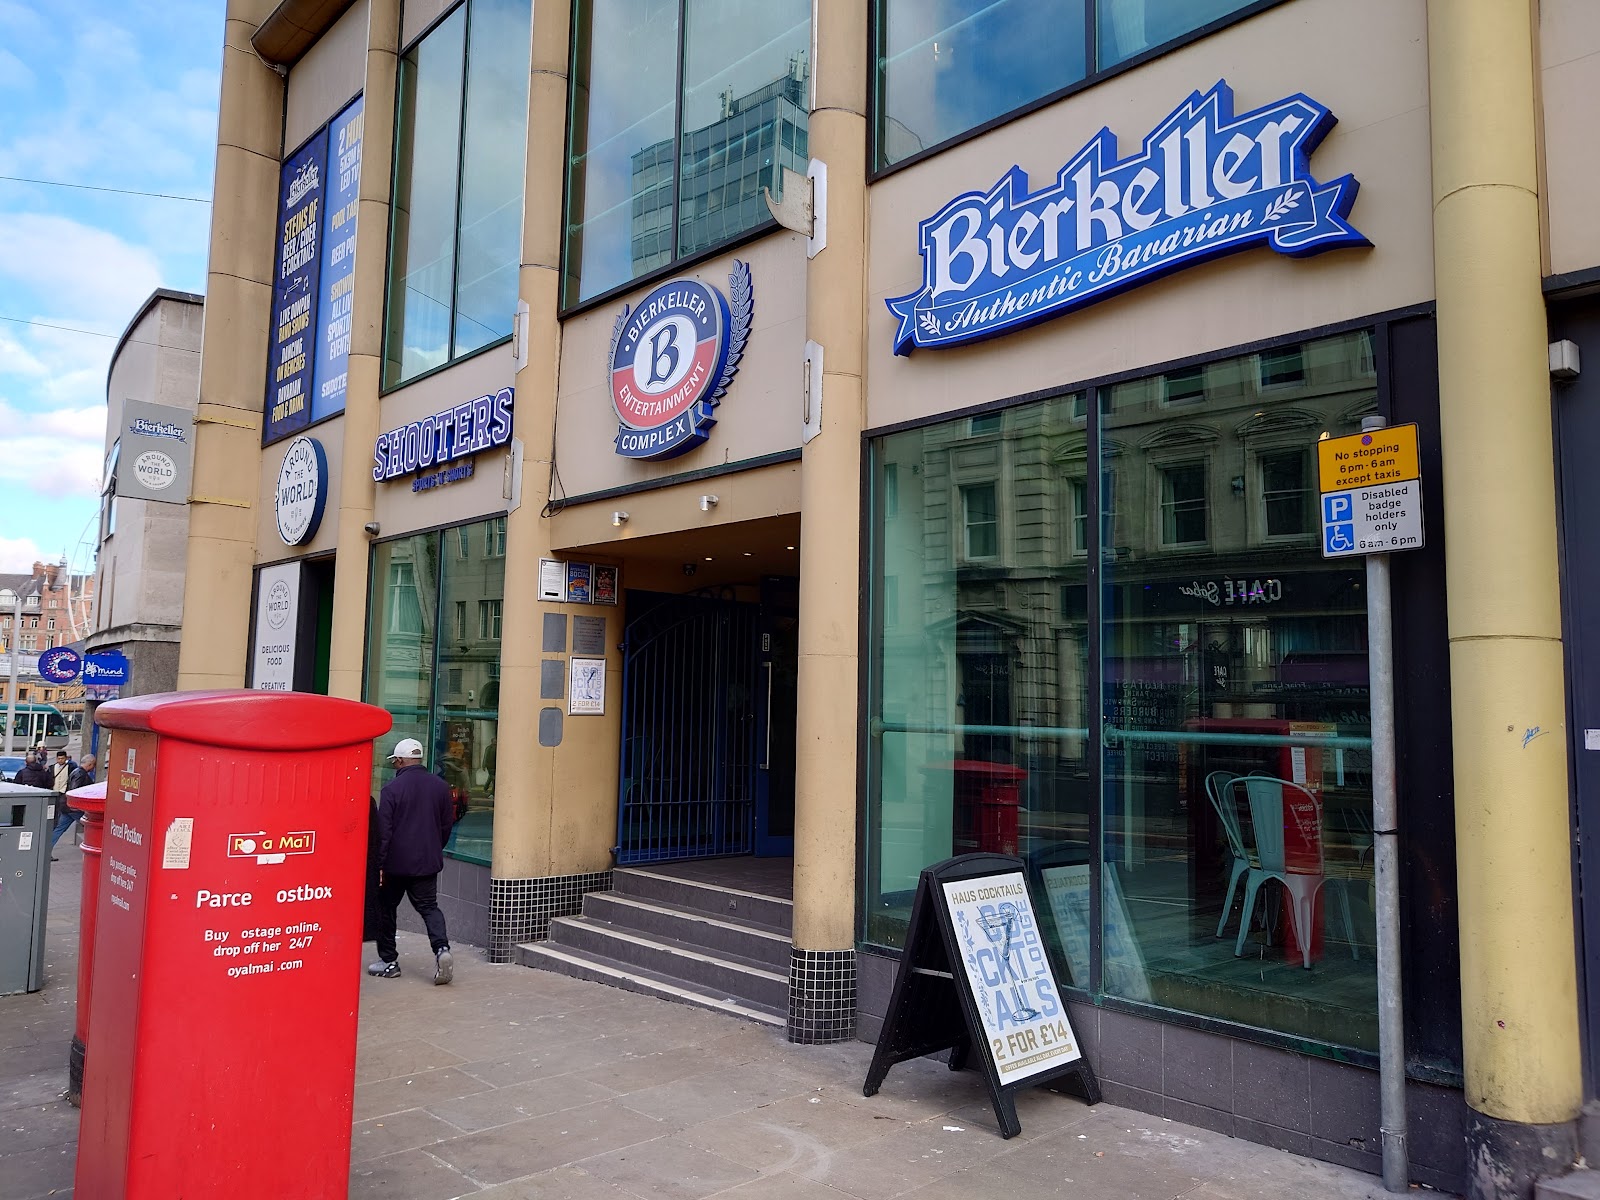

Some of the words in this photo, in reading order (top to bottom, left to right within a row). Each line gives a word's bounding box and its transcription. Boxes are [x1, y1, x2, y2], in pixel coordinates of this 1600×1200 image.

[338, 127, 345, 156] 2
[930, 112, 1303, 300] Bierkeller
[284, 204, 308, 244] STEINS
[308, 197, 318, 224] OF
[331, 207, 346, 233] POOL
[286, 240, 315, 276] COCKTAILS
[331, 241, 345, 267] BEER
[944, 270, 1084, 333] Authentic
[1088, 208, 1254, 284] Bavarian
[279, 305, 290, 326] LIVE
[331, 299, 342, 320] ALL
[627, 290, 706, 343] BIERKELLER
[646, 321, 680, 389] B
[619, 361, 705, 417] ENTERTAINMENT
[135, 419, 185, 437] Bierkeller
[373, 387, 513, 482] SHOOTERS
[621, 418, 686, 451] COMPLEX
[141, 454, 171, 468] AROUND
[285, 447, 314, 480] AROUND
[1335, 452, 1349, 461] No
[1353, 444, 1400, 458] stopping
[138, 465, 172, 477] WORLD
[294, 469, 304, 480] THE
[1336, 473, 1371, 486] except
[1374, 469, 1401, 480] taxis
[282, 479, 314, 506] WORLD
[1361, 486, 1408, 501] Disabled
[1331, 497, 1348, 520] P
[1365, 510, 1406, 521] holders
[1369, 500, 1401, 511] badge
[1375, 521, 1398, 531] only
[269, 600, 288, 612] WORLD
[262, 645, 290, 654] DELICIOUS
[98, 667, 124, 675] mind
[267, 657, 283, 666] FOOD
[261, 682, 286, 690] CREATIVE
[110, 818, 124, 838] Parcel
[124, 823, 143, 846] Postbox
[196, 889, 252, 908] Parce
[276, 883, 333, 903] ostbox
[952, 891, 977, 905] HAUS
[977, 883, 1024, 901] COCKTAILS
[204, 930, 229, 943] Buy
[241, 926, 281, 939] ostage
[285, 921, 322, 935] online,
[1015, 899, 1047, 976] LODGE
[213, 945, 241, 957] drop
[243, 942, 260, 954] off
[262, 941, 281, 953] her
[289, 935, 313, 950] 24/7
[992, 1038, 1006, 1061] 2
[1006, 1028, 1039, 1057] FOR
[1039, 1020, 1068, 1046] £14
[1004, 1062, 1018, 1071] OFFER
[1017, 1057, 1036, 1069] AVAILABLE
